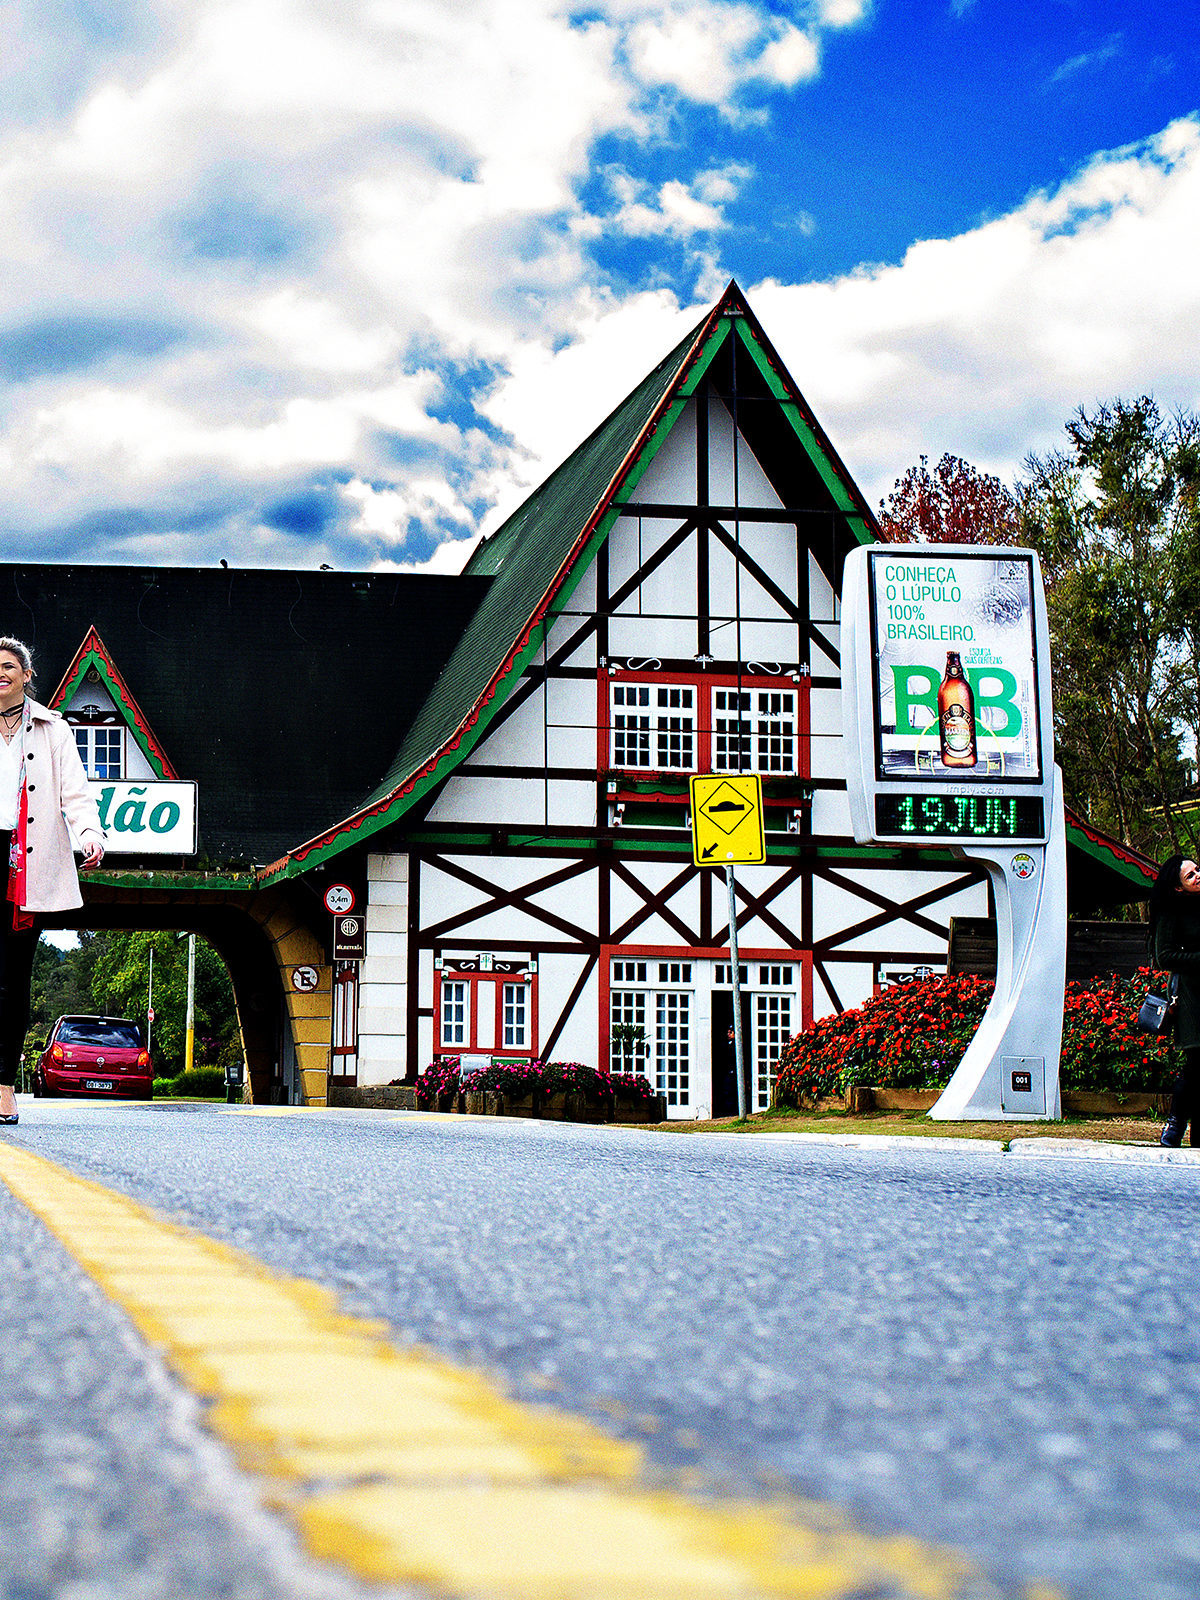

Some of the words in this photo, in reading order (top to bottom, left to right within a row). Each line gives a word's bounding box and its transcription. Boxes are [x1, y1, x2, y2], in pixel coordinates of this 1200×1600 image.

[885, 565, 957, 585] CONHEÇA
[886, 585, 897, 601] O
[902, 583, 962, 603] LÚPULO
[887, 604, 926, 621] 100%
[887, 623, 977, 641] BRASILEIRO.
[946, 784, 1005, 796] imply.com
[1015, 1076, 1028, 1084] 001
